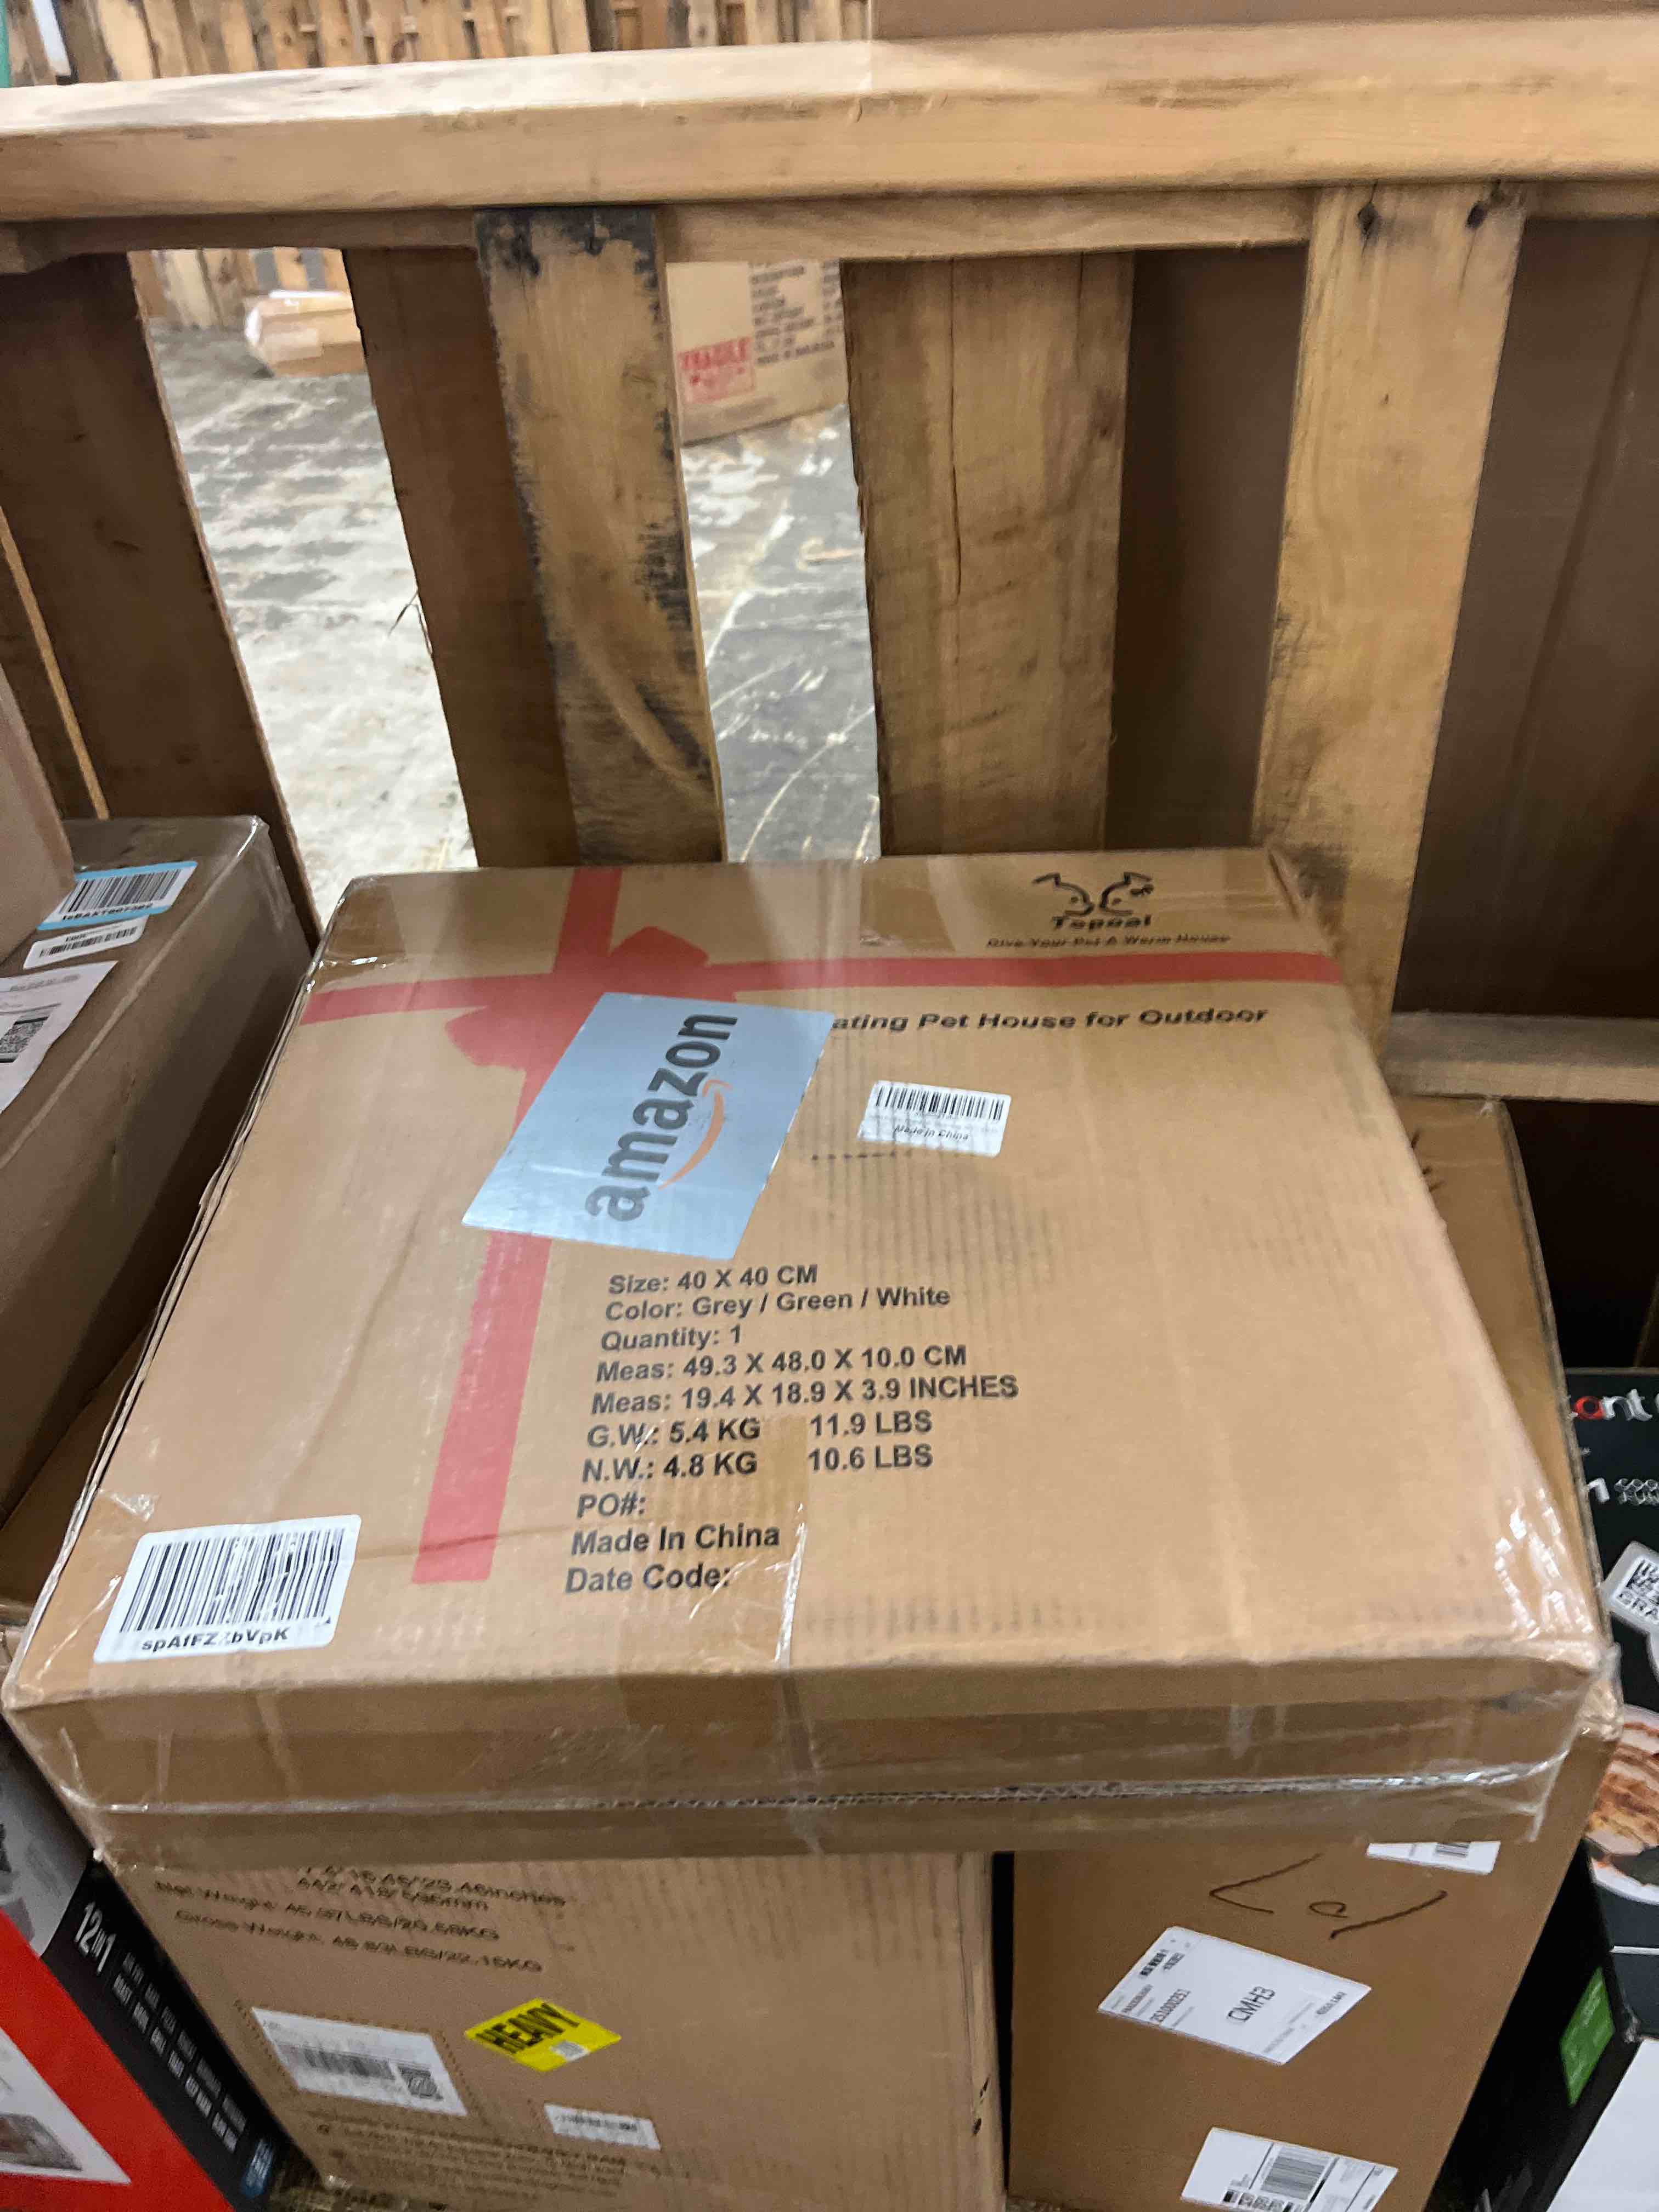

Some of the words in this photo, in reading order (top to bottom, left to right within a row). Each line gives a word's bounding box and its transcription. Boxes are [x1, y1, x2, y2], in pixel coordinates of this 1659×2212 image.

[918, 1012, 968, 1029] Pet
[977, 1012, 1076, 1029] House
[1085, 1011, 1130, 1028] for
[1139, 1007, 1269, 1025] Outdoor
[585, 1014, 738, 1222] amazon
[609, 1274, 669, 1294] Size:
[676, 1271, 707, 1290] 40
[715, 1269, 731, 1288] X
[740, 1268, 768, 1287] 40
[777, 1265, 818, 1284] CM
[606, 1300, 682, 1321] Color:
[692, 1296, 752, 1319] Grey
[759, 1294, 769, 1313] /
[776, 1291, 853, 1311] Green
[860, 1289, 868, 1307] /
[877, 1287, 951, 1306] White
[601, 1327, 719, 1350] Quantity:
[730, 1325, 741, 1344] 1
[596, 1361, 674, 1382] Meas:
[683, 1356, 737, 1376] 49.3
[744, 1353, 764, 1374] X
[771, 1350, 825, 1371] 48.0
[834, 1349, 854, 1368] X
[861, 1346, 915, 1368] 10.0
[924, 1345, 967, 1365] CM
[591, 1391, 671, 1414] Meas:
[681, 1388, 735, 1408] 19.4
[743, 1386, 763, 1406] X
[771, 1383, 826, 1403] 18.9
[834, 1381, 854, 1401] X
[861, 1379, 900, 1401] 3.9
[909, 1375, 1019, 1399] INCHES
[669, 1421, 708, 1443] 5.4
[718, 1418, 761, 1440] KG
[809, 1413, 866, 1436] 11.9
[876, 1410, 932, 1433] LBS
[582, 1458, 653, 1482] N.W.:
[663, 1455, 704, 1478] 4.8
[714, 1452, 757, 1475] KG
[808, 1447, 865, 1471] 10.6
[875, 1444, 933, 1468] LBS
[577, 1494, 646, 1517] PO#:
[571, 1530, 649, 1555] Made
[659, 1527, 685, 1549] In
[695, 1524, 780, 1549] China
[566, 1567, 632, 1593] Date
[644, 1562, 731, 1589] Code:
[1226, 1985, 1276, 2022] CMH3
[475, 2002, 580, 2054] HEAVY
